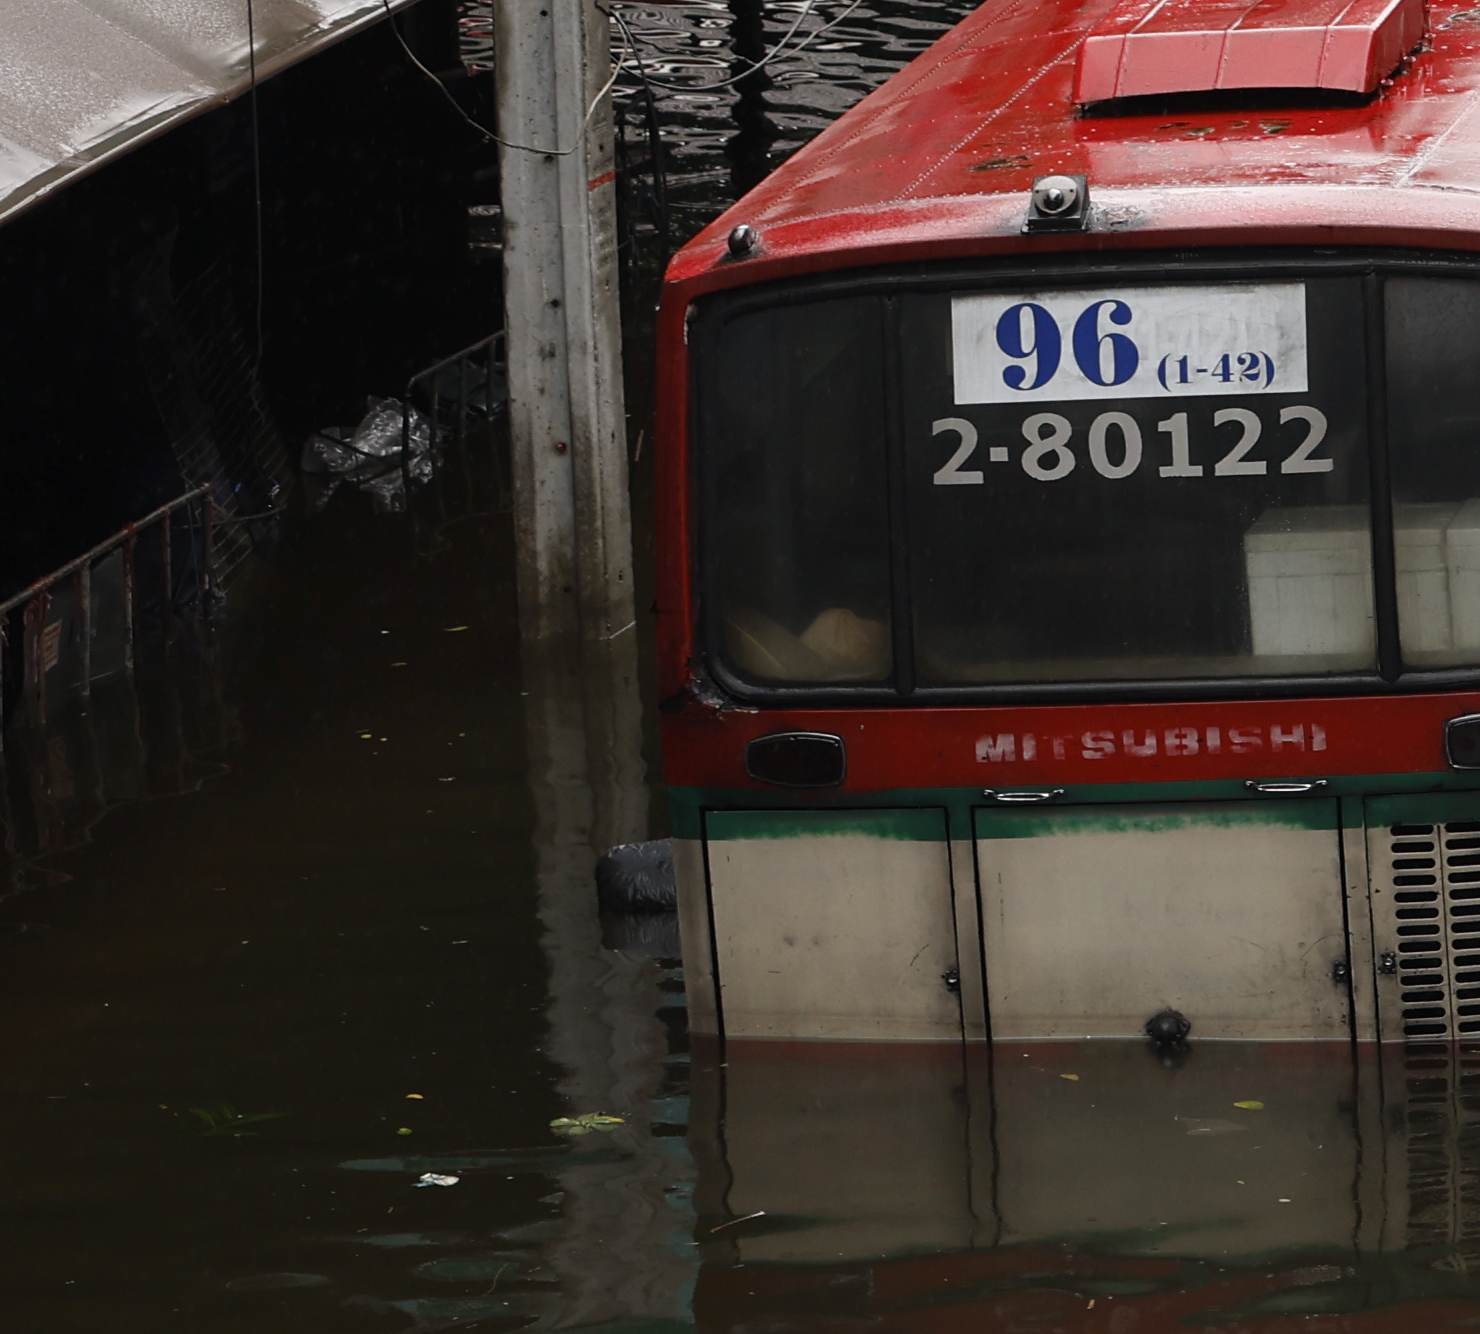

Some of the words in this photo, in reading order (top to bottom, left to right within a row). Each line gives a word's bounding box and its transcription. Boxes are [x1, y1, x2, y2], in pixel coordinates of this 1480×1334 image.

[996, 299, 1140, 391] 96
[1157, 350, 1276, 393] (1-42)
[931, 405, 1334, 485] 2-80122
[975, 723, 1327, 763] MITSUBISHI
